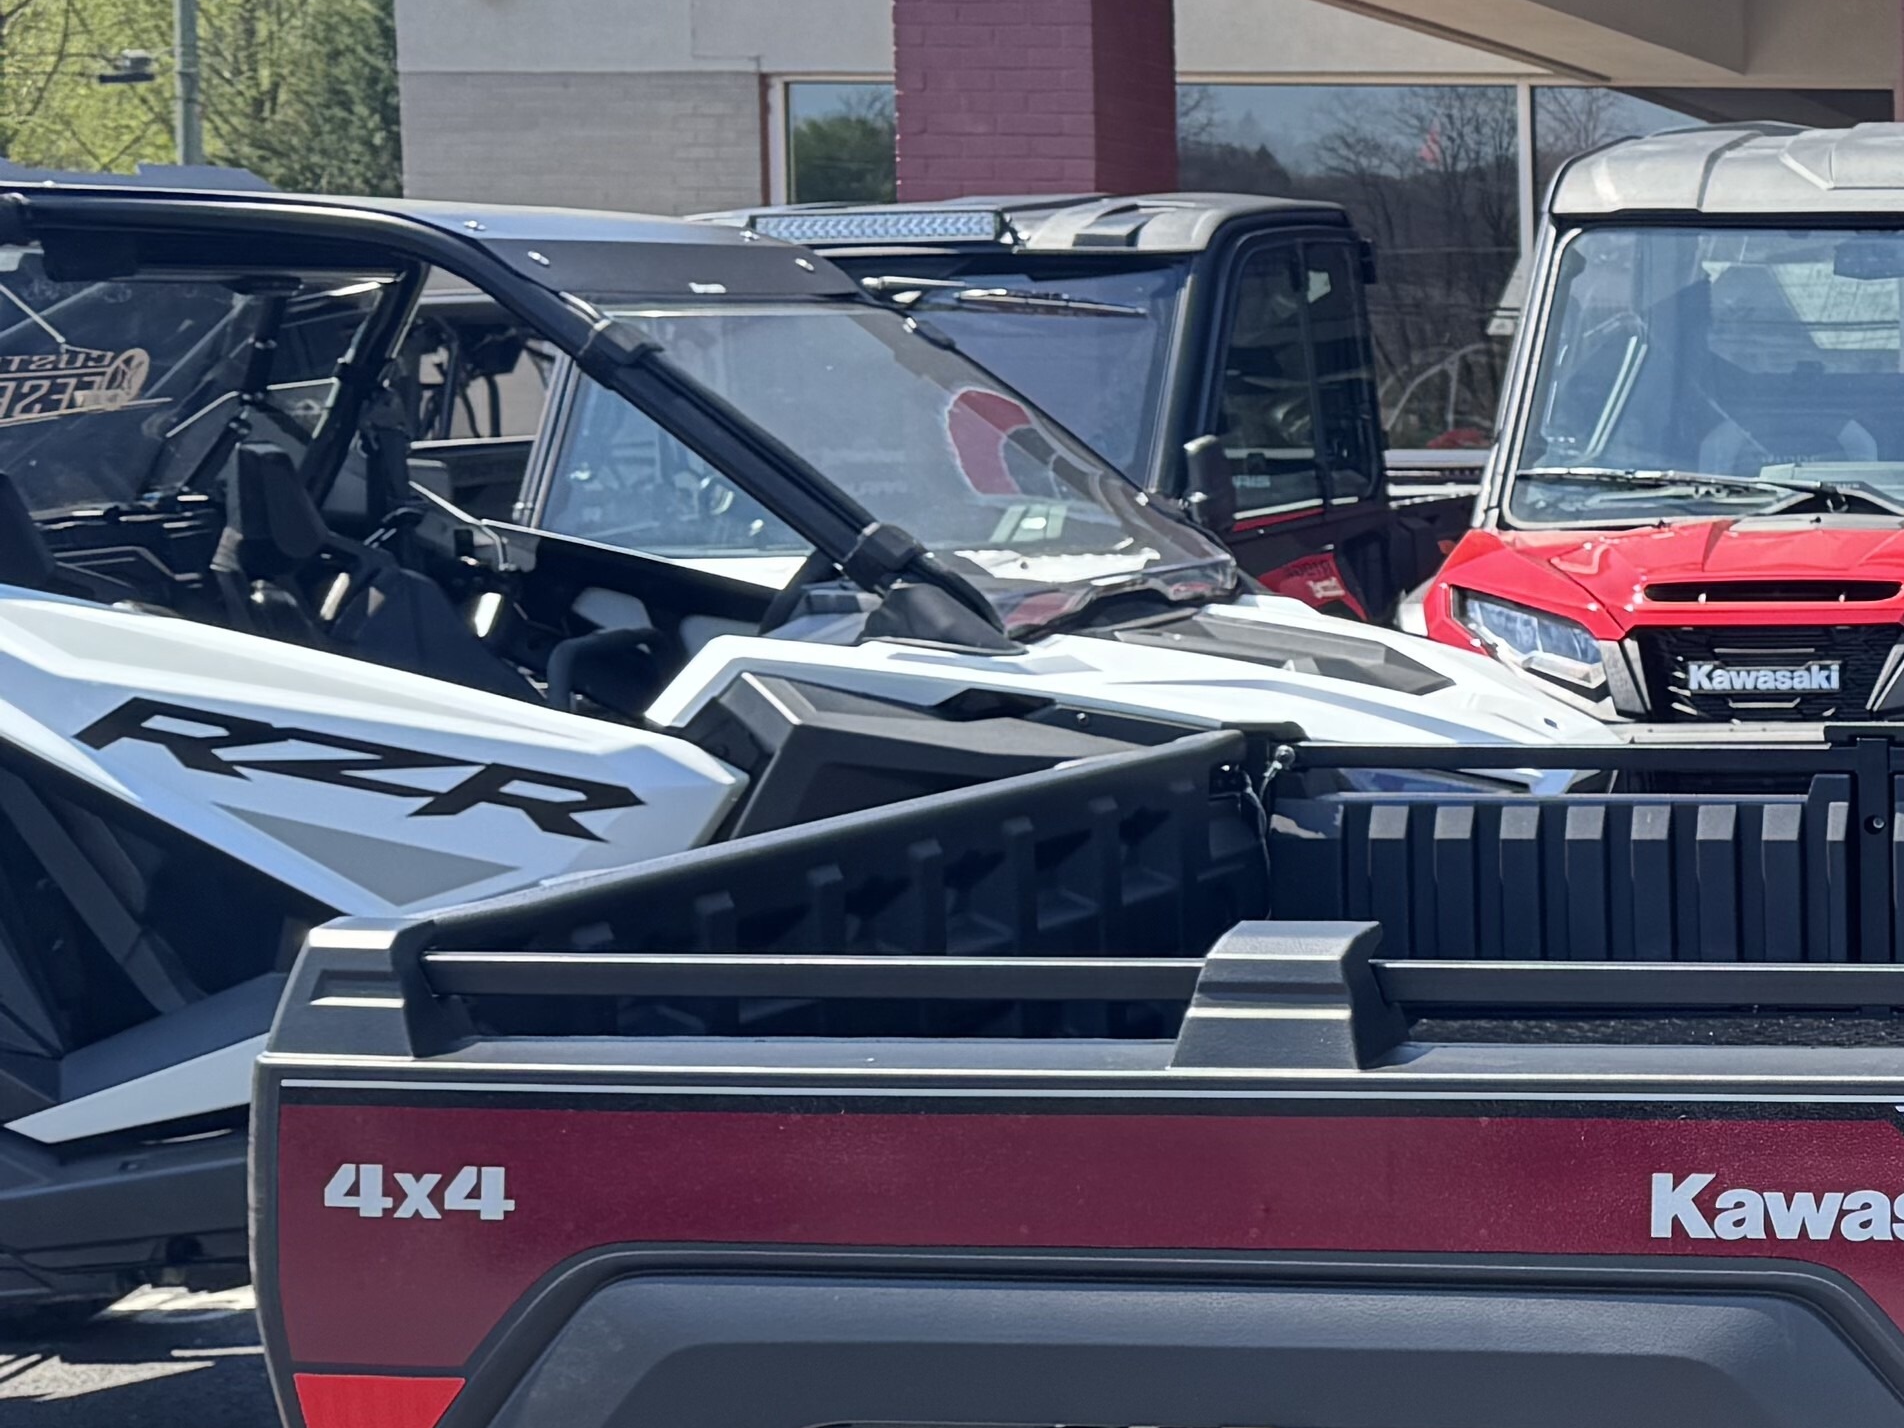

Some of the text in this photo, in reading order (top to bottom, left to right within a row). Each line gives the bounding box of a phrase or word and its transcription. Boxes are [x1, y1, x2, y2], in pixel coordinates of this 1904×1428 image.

[1688, 664, 1840, 690] Kawasaki
[74, 697, 647, 843] RZR
[324, 1163, 516, 1221] 4x4
